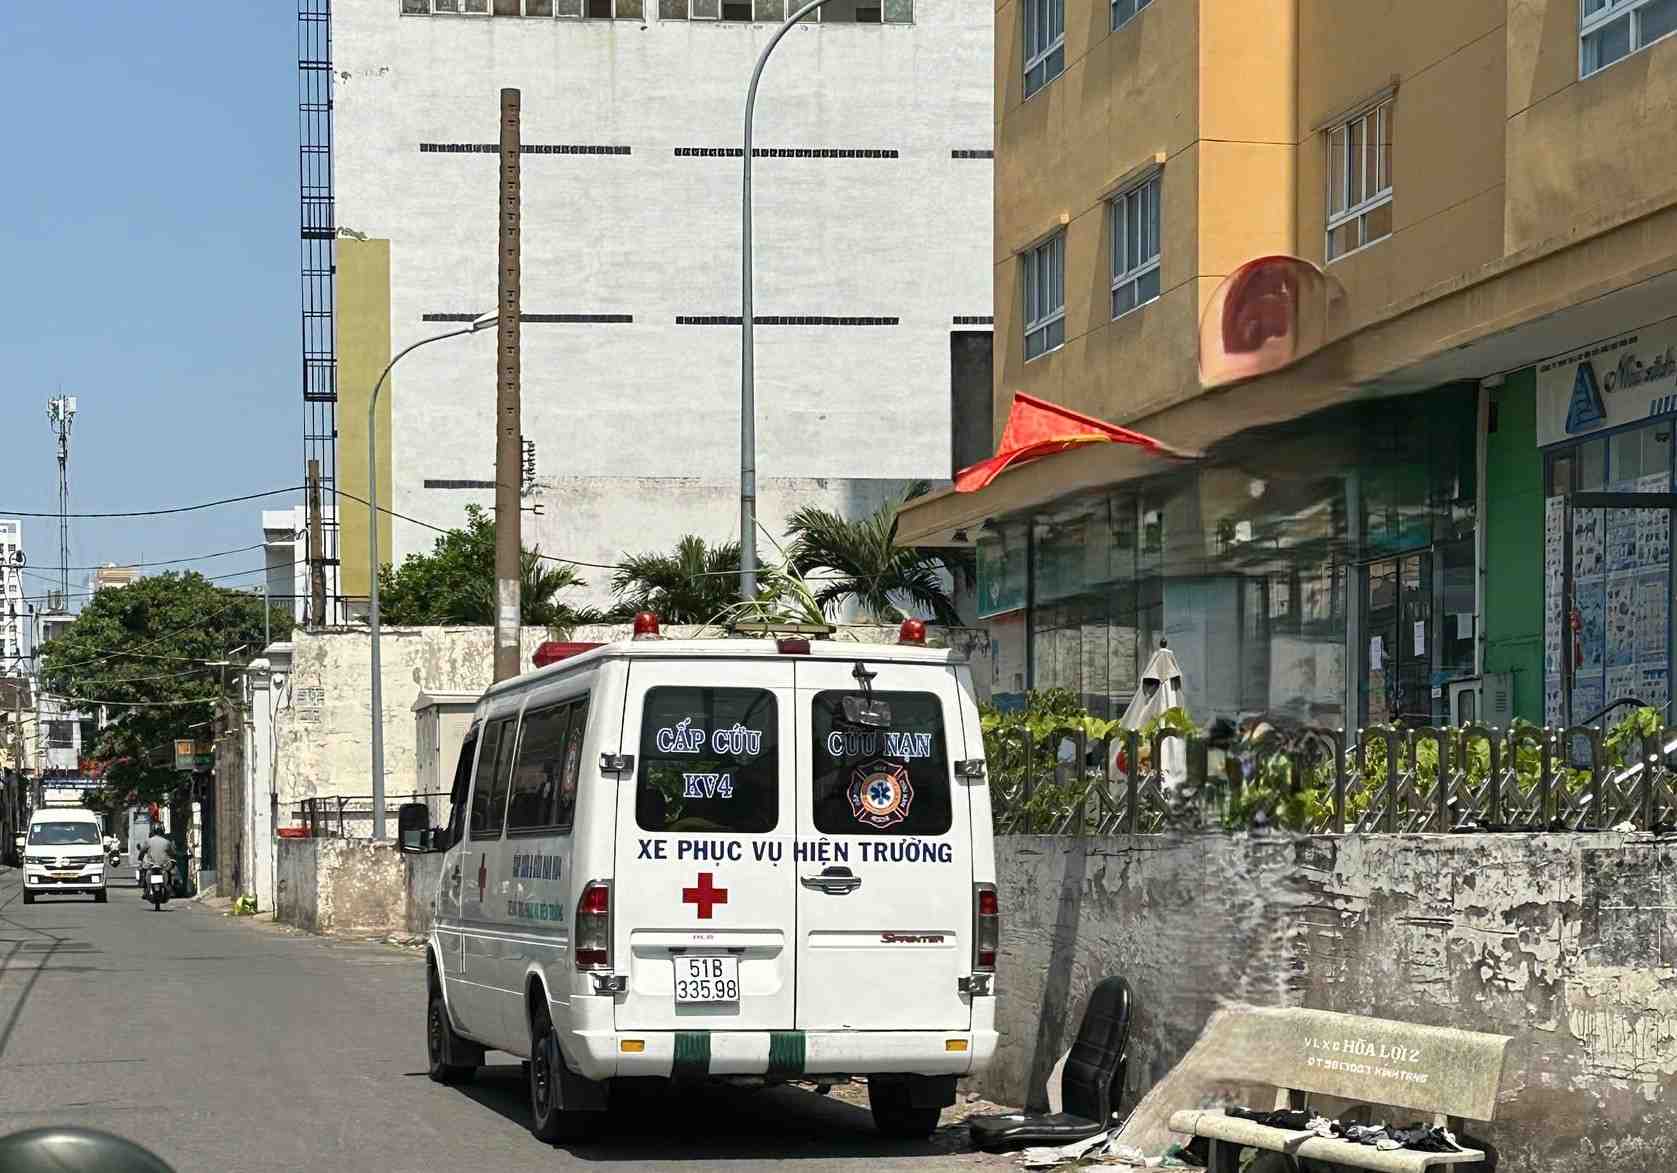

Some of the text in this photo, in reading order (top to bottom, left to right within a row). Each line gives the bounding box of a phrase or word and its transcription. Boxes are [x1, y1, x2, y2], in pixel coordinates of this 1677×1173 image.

[656, 717, 762, 755] CẤP CỨU
[682, 773, 734, 798] KV4
[637, 837, 952, 867] XE PHỤC VỤ HIỆN TRƯỜNG
[689, 959, 723, 978] 51B
[678, 979, 737, 999] 335.98
